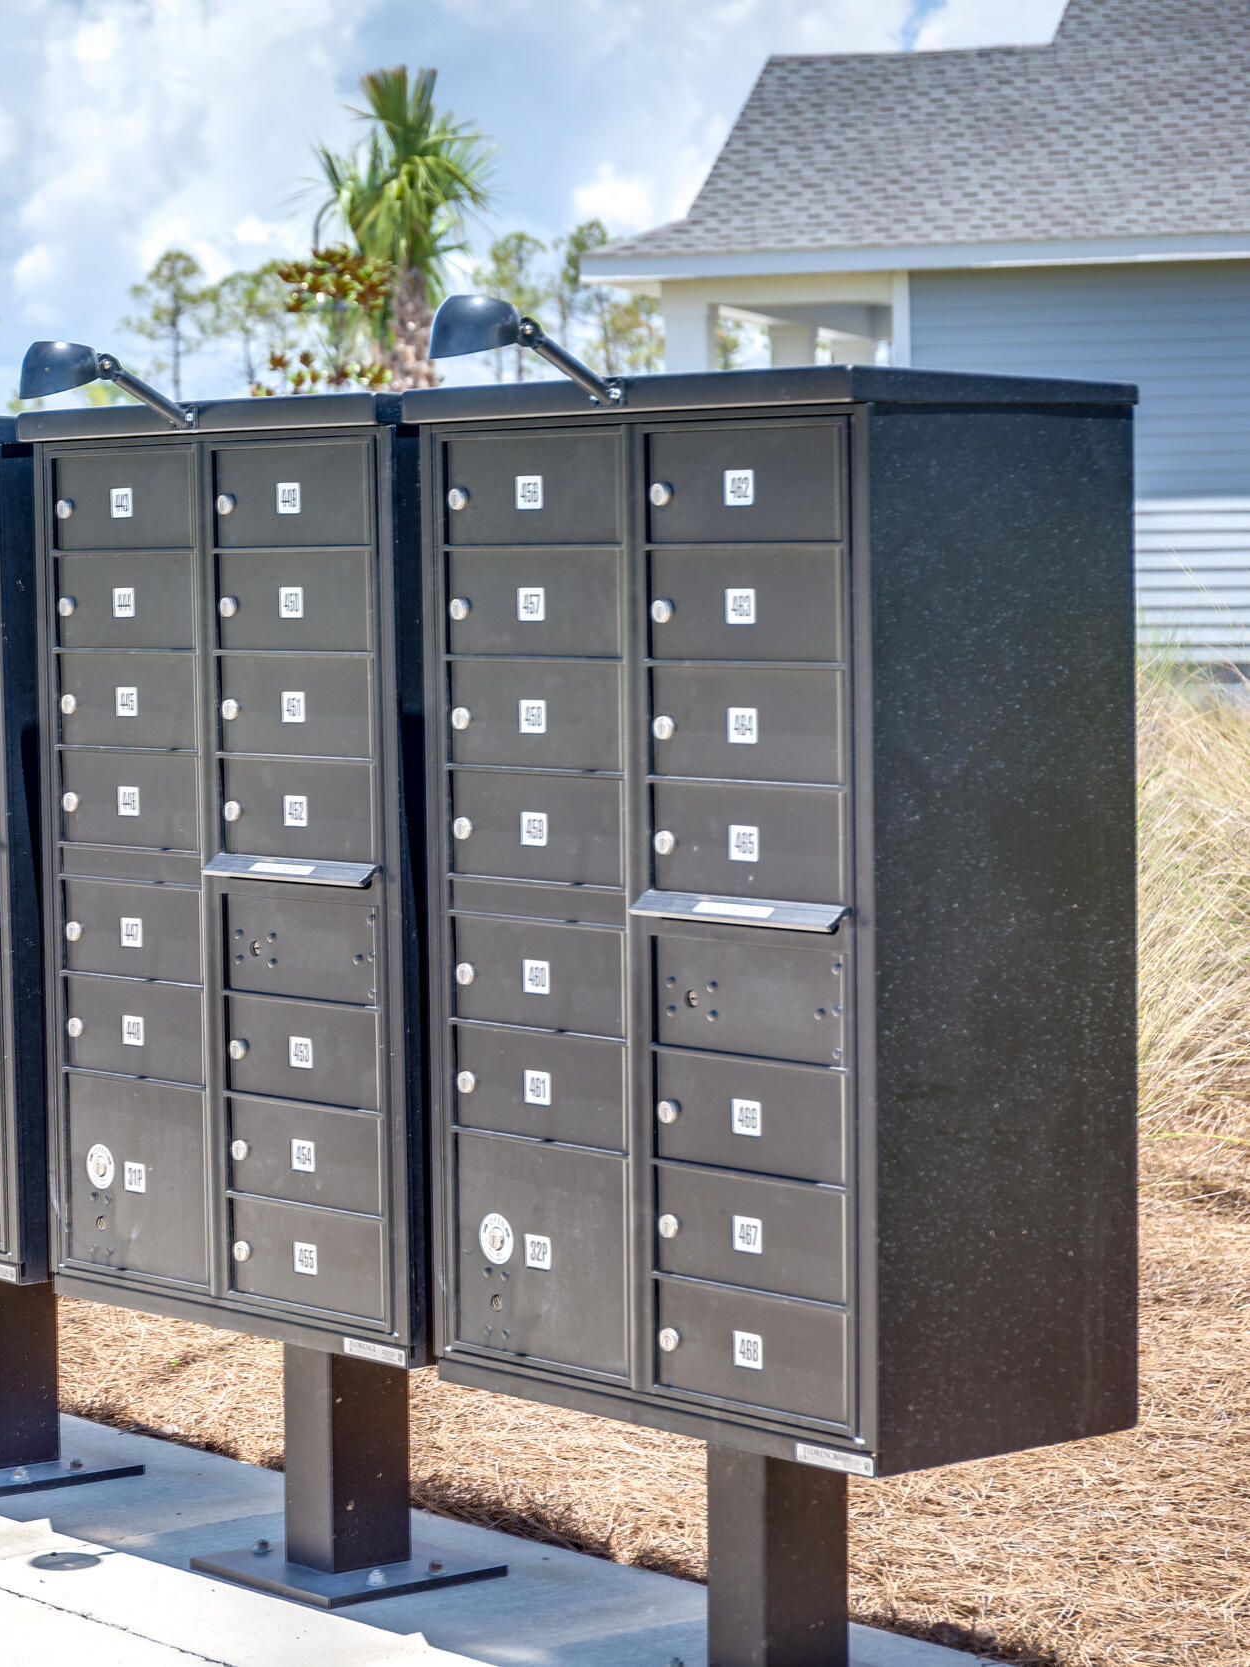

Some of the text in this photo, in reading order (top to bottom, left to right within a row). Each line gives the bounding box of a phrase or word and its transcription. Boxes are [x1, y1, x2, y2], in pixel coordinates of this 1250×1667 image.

[281, 488, 297, 508] 449
[520, 482, 539, 503] 456
[730, 476, 749, 499] 462
[114, 493, 129, 512] 443
[117, 593, 132, 613] 444
[283, 593, 300, 613] 450
[522, 593, 541, 615] 457
[731, 595, 751, 617] 463
[120, 692, 135, 711] 445
[286, 697, 301, 717] 451
[524, 706, 543, 727] 458
[733, 714, 753, 736] 464
[121, 792, 137, 811] 446
[288, 801, 304, 821] 452
[526, 818, 544, 840] 459
[734, 832, 755, 855] 465
[124, 923, 139, 941] 447
[528, 966, 546, 988] 460
[126, 1021, 141, 1041] 448
[293, 1042, 310, 1063] 453
[529, 1077, 546, 1098] 461
[737, 1106, 757, 1129] 466
[296, 1145, 312, 1166] 454
[128, 1167, 143, 1186] 31P
[739, 1223, 758, 1246] 467
[298, 1248, 314, 1269] 455
[530, 1240, 548, 1262] 32P
[739, 1339, 759, 1362] 468
